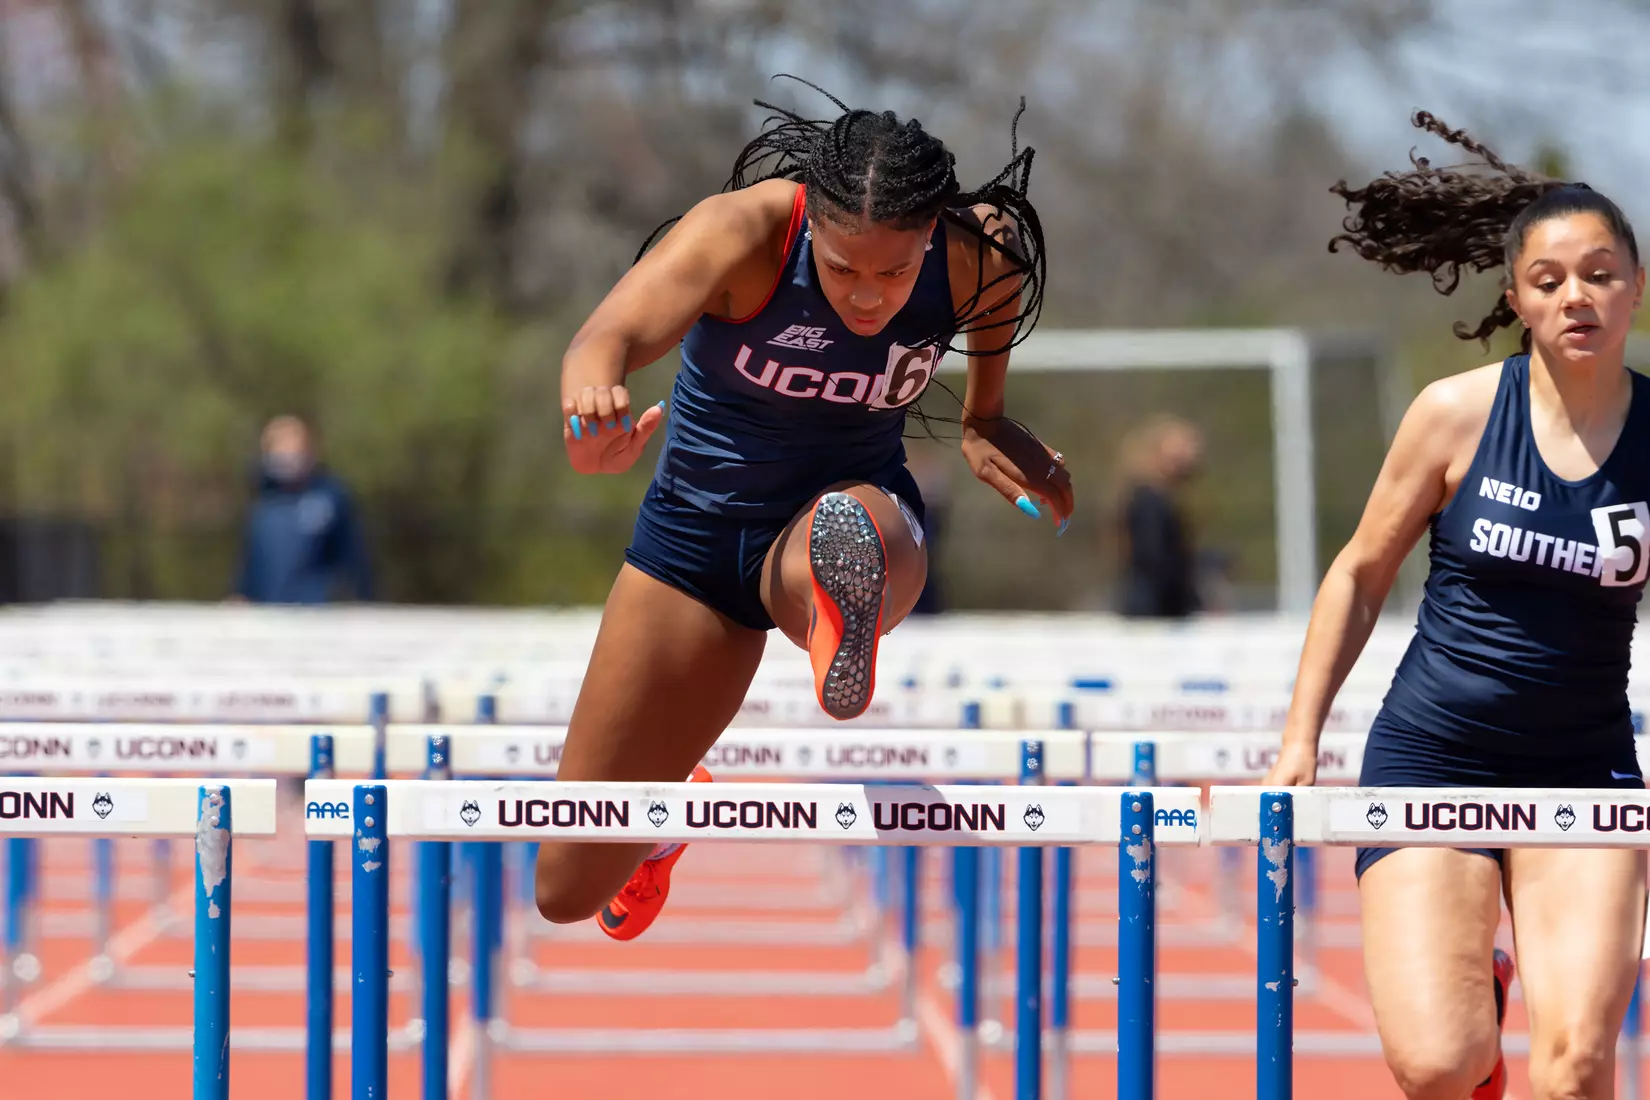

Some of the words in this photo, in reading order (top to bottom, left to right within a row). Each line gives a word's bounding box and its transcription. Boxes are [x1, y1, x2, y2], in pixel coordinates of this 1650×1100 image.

[772, 332, 835, 349] EAST
[782, 324, 827, 338] BIG
[734, 344, 887, 405] UCO
[884, 348, 932, 405] 6
[1479, 476, 1541, 511] NE10
[1607, 508, 1641, 582] 5
[115, 736, 218, 760] UCONN
[703, 743, 782, 767] CONN
[825, 746, 928, 768] UCONN
[498, 799, 629, 828] UCONN
[686, 800, 817, 830] UCONN
[873, 802, 1005, 832] UCONN
[1405, 802, 1537, 831] UCONN
[1592, 804, 1650, 833] UC
